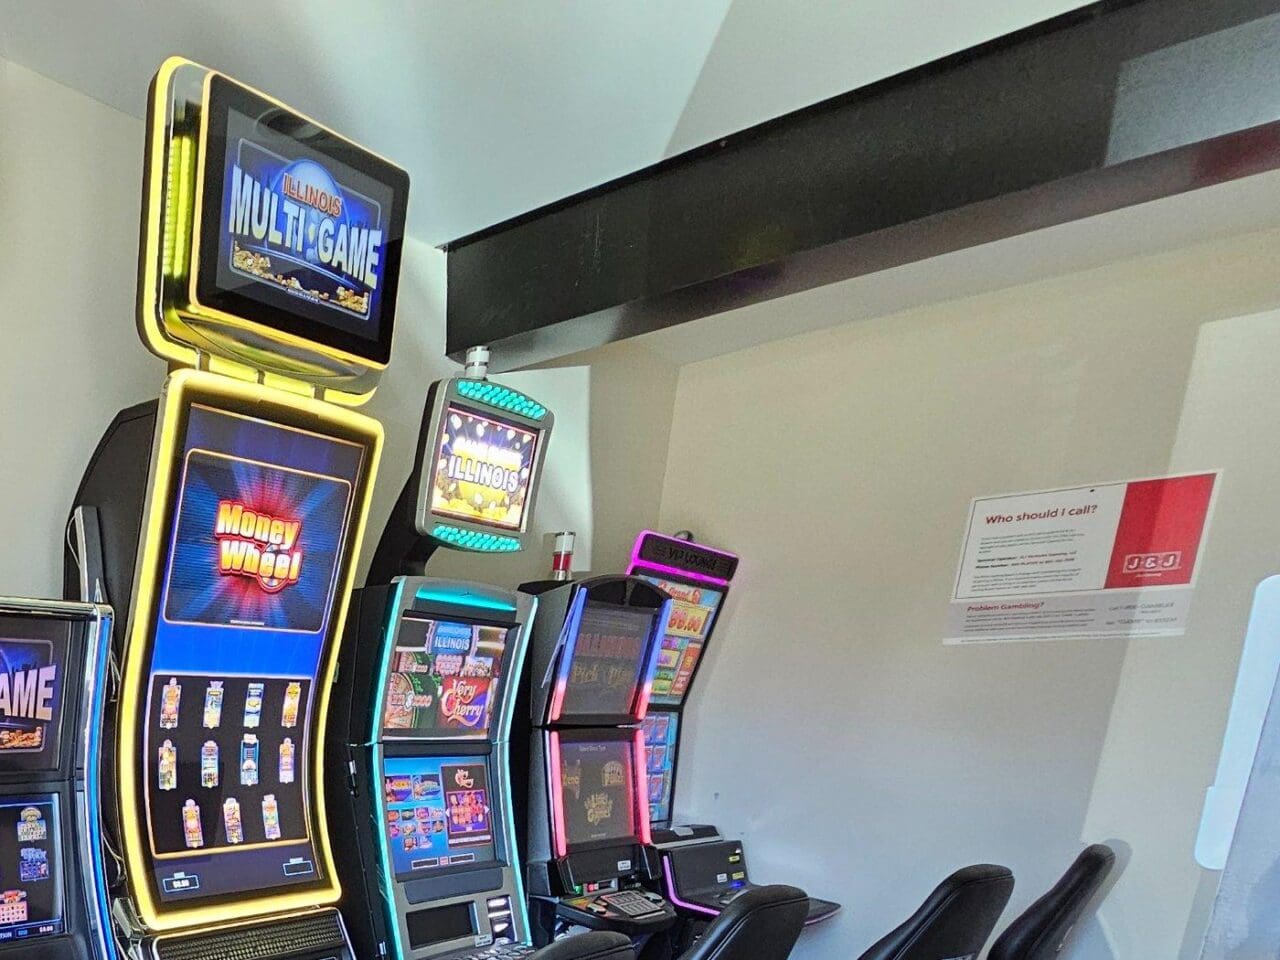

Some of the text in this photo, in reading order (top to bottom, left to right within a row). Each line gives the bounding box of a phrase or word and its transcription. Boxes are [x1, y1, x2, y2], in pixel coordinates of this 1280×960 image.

[284, 172, 342, 217] ILLINOIS
[229, 164, 383, 290] MULTI GAME
[448, 455, 519, 493] ILLINOIS
[216, 503, 300, 549] Money
[986, 504, 1098, 525] Who should I call?
[220, 540, 302, 582] Wheel
[967, 602, 1045, 612] Problem Gambling?
[434, 637, 470, 650] ILLINOIS
[442, 689, 484, 722] Cherry
[453, 679, 477, 704] Very
